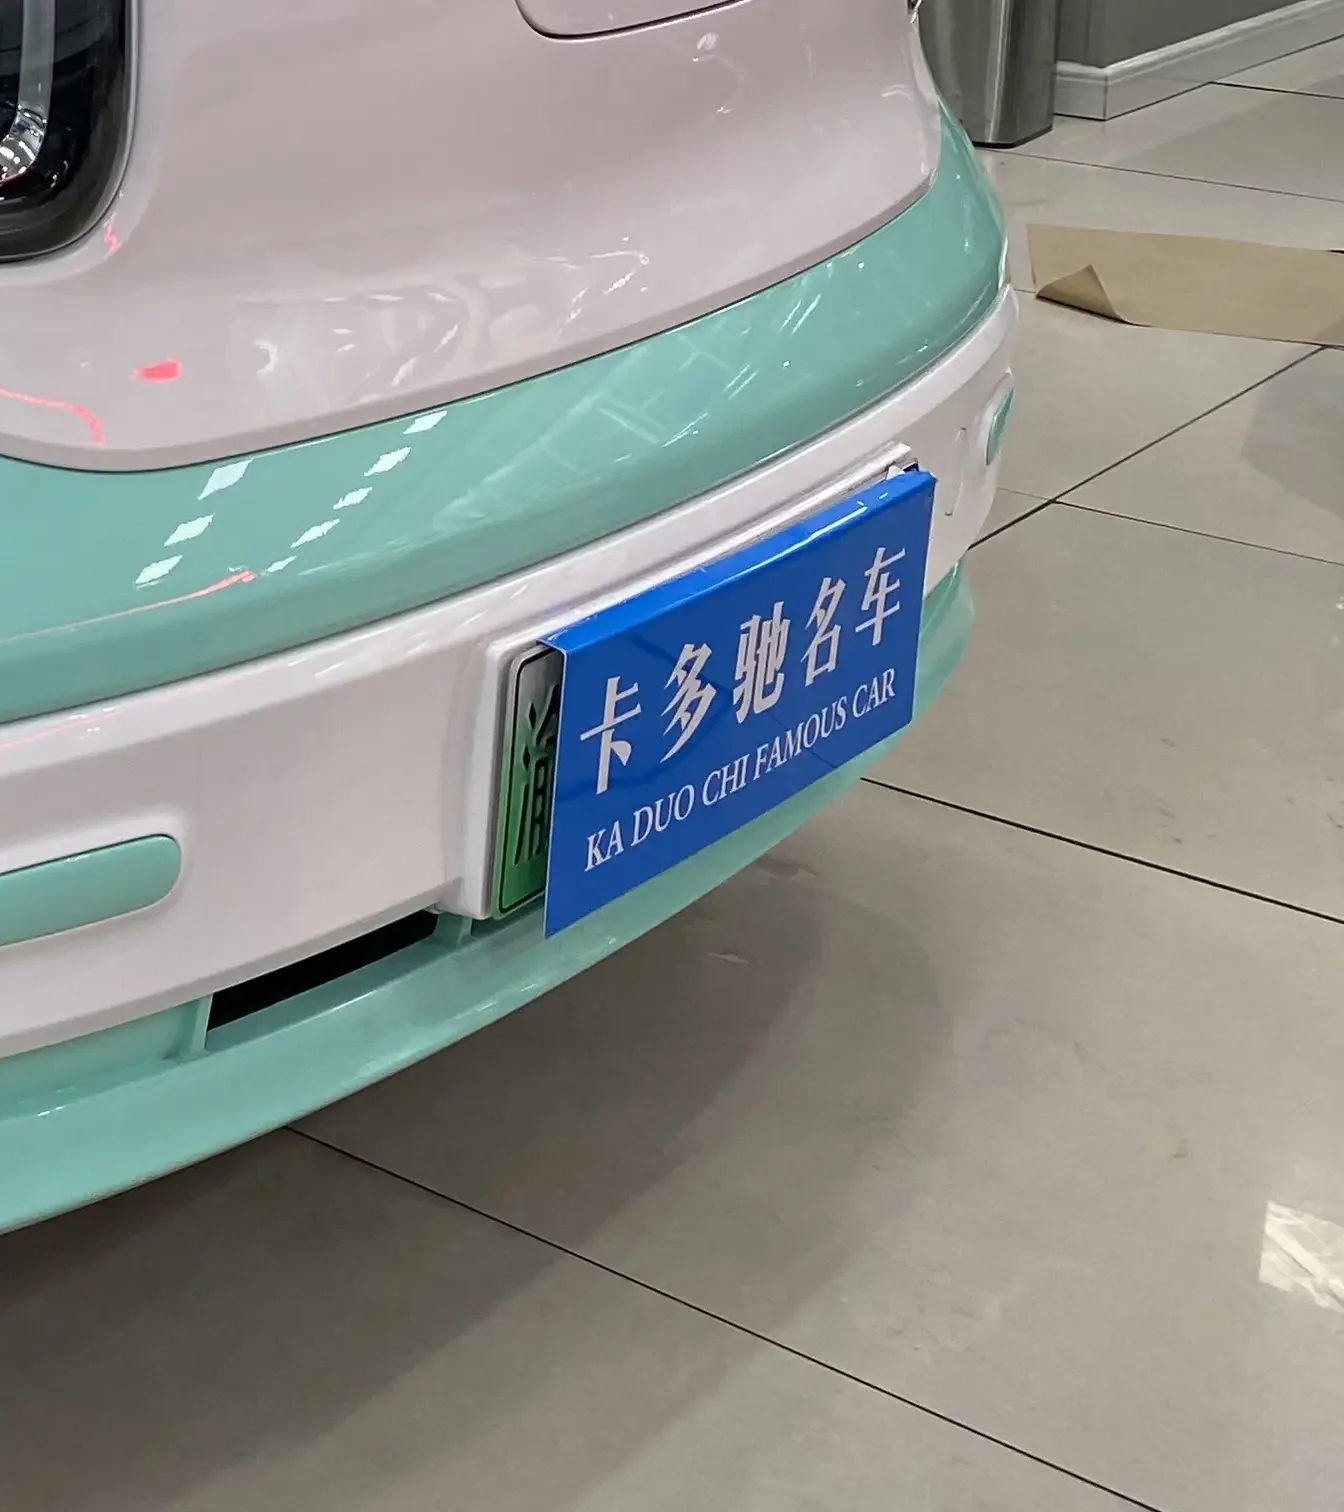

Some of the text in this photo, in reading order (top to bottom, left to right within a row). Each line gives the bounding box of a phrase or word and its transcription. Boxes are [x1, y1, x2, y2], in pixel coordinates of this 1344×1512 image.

[580, 546, 907, 795] 卡多驰名车
[583, 667, 896, 872] KA DUO CHI FAMOUS CAR
